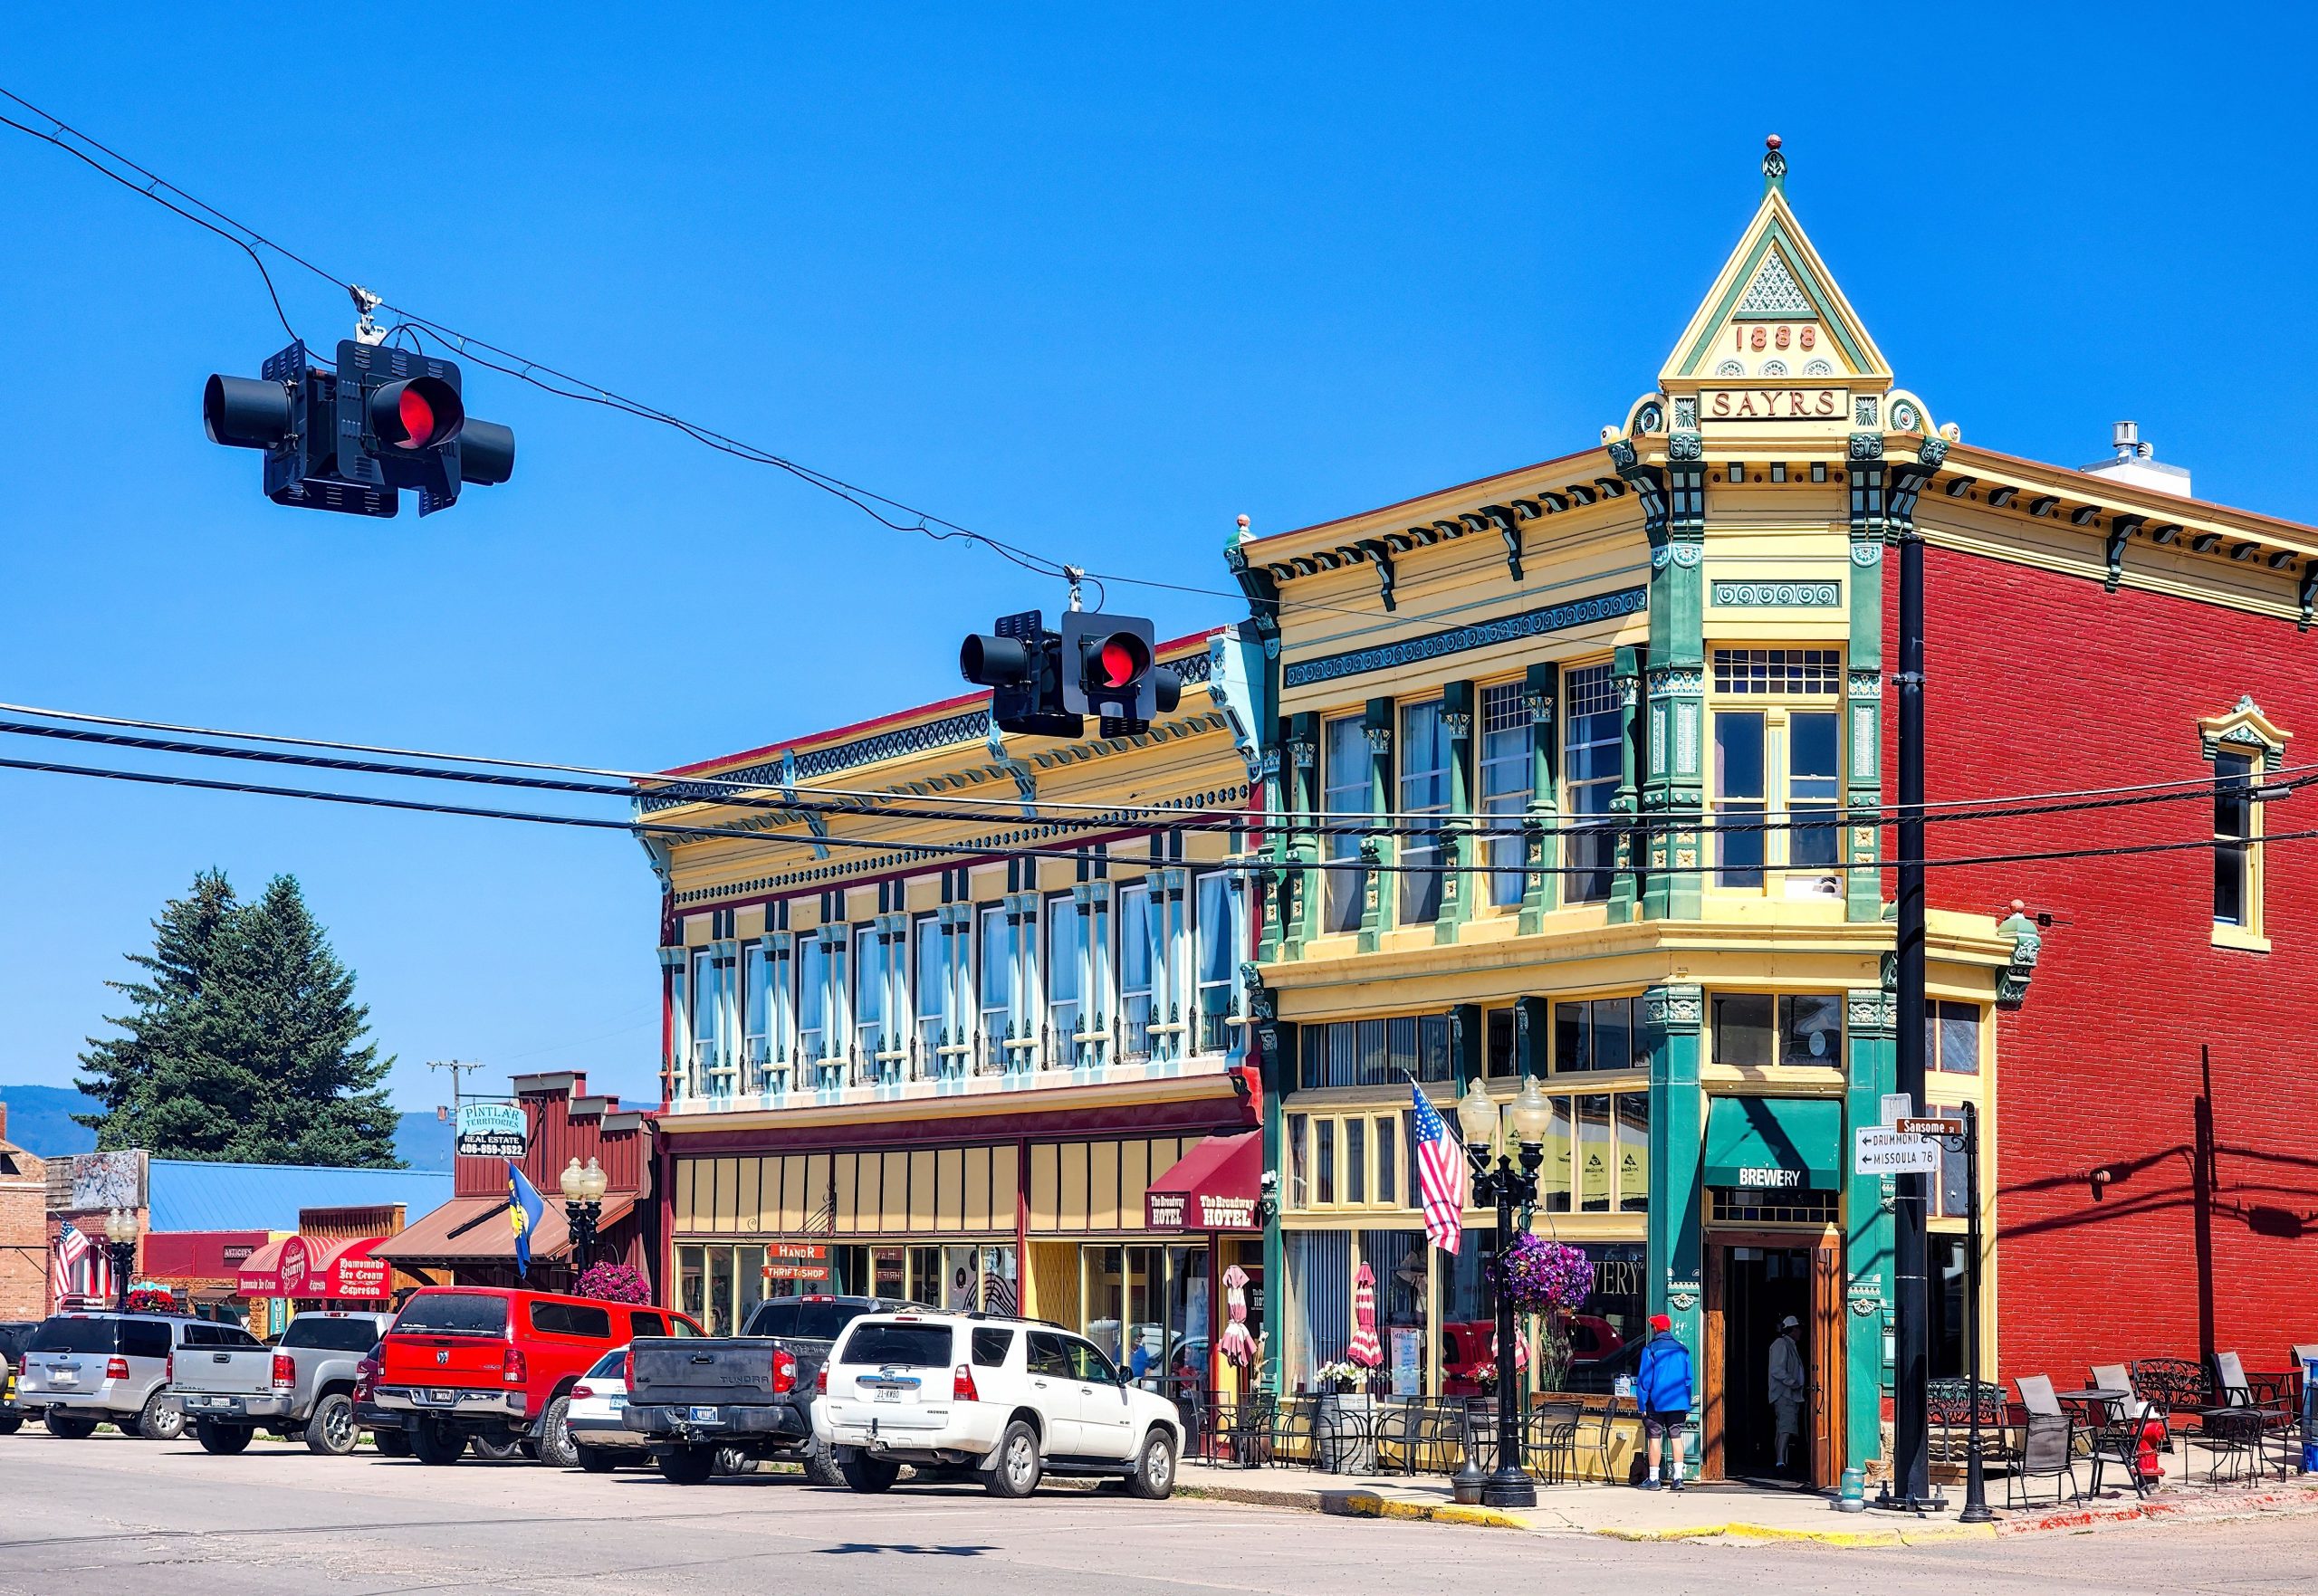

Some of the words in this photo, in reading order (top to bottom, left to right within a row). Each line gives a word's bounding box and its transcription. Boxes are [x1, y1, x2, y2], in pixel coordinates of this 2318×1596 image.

[1736, 325, 1816, 349] 1888
[1712, 390, 1835, 417] SAYRS
[465, 1106, 520, 1121] PINTLAR
[465, 1117, 519, 1129] TERRITORIES
[1903, 1120, 1945, 1133] Sansome
[464, 1135, 486, 1143] REAL
[488, 1136, 520, 1144] ESTATE
[1873, 1133, 1919, 1146] DRUMMOND
[1873, 1152, 1917, 1165] MISSOULA
[1921, 1152, 1933, 1163] 78
[1739, 1168, 1801, 1187] BREWERY
[1151, 1195, 1160, 1208] The
[1160, 1195, 1185, 1209] Broadway
[1200, 1195, 1215, 1208] The
[1215, 1195, 1255, 1211] Broadway
[1153, 1208, 1183, 1225] HOTEL
[1202, 1209, 1251, 1227] HOTEL
[340, 1257, 385, 1269] Homemade
[339, 1268, 354, 1279] Ice
[355, 1269, 384, 1280] Cream
[768, 1267, 798, 1277] THRIFT
[800, 1269, 825, 1278] SHOP
[339, 1285, 380, 1295] Espresso
[720, 1375, 769, 1384] TUNDRA
